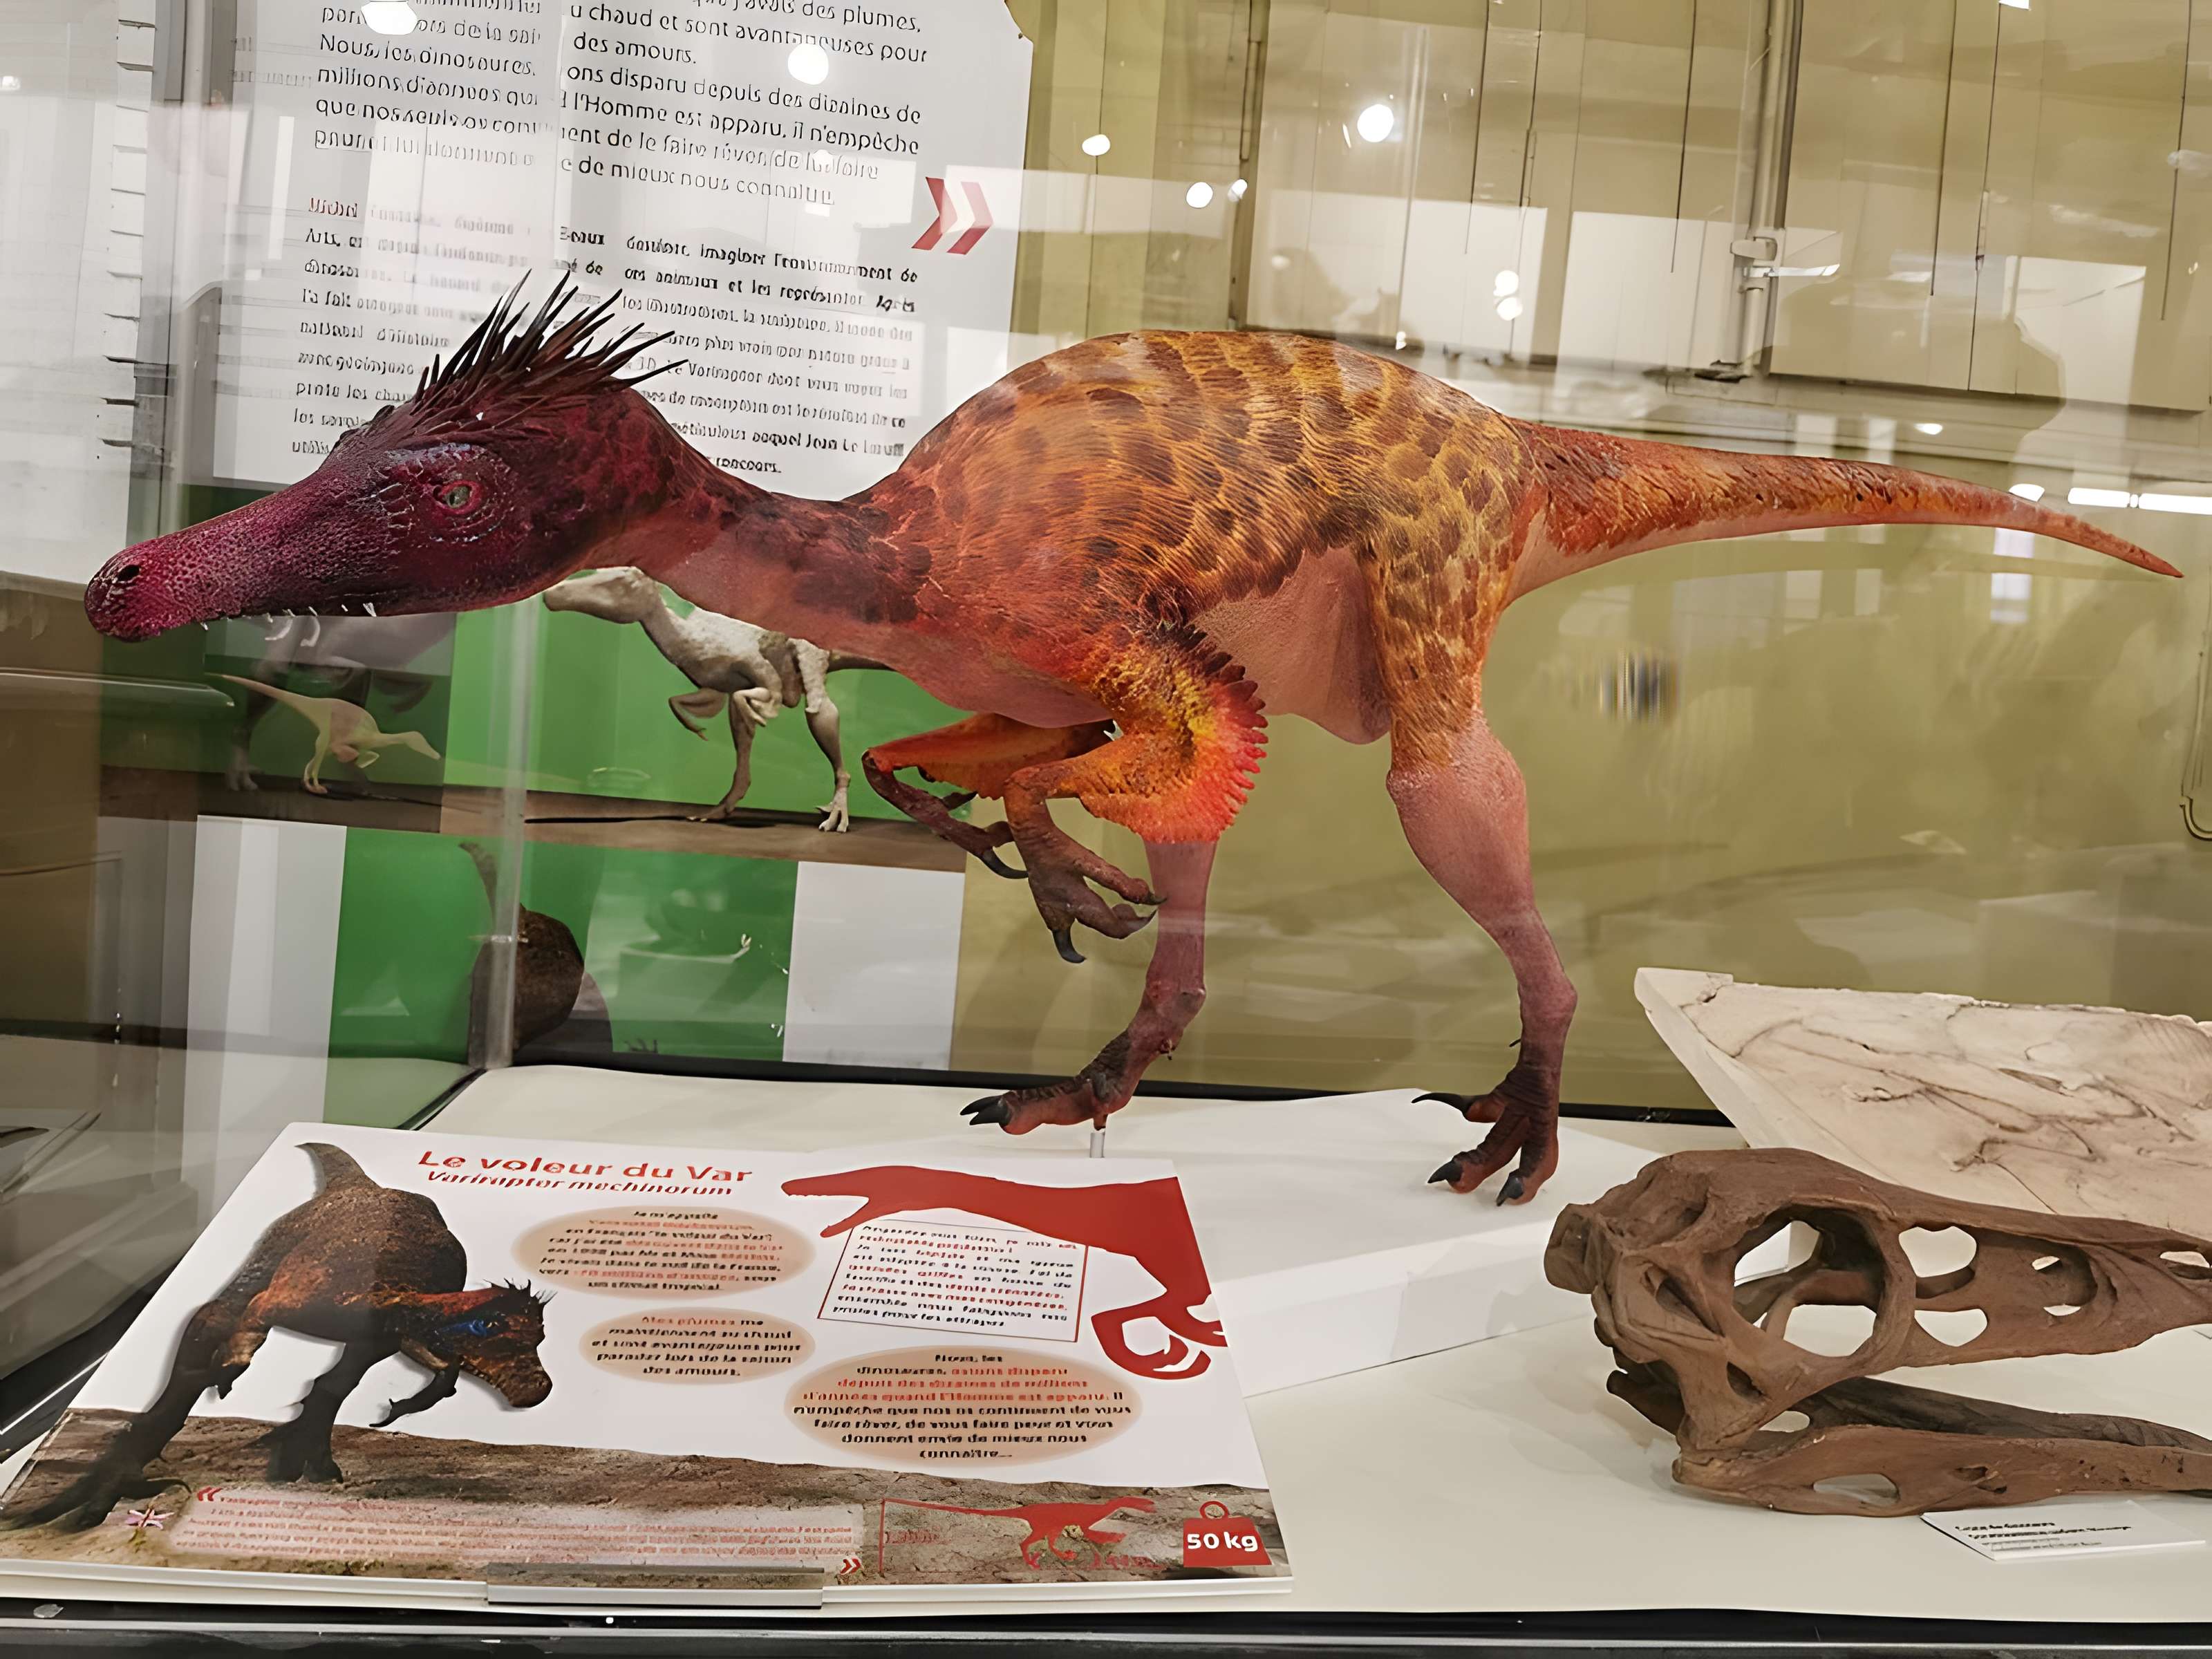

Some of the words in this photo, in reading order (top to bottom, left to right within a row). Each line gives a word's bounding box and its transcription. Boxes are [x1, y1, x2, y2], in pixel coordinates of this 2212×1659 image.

[574, 32, 608, 52] des
[590, 3, 652, 26] chaud
[685, 19, 729, 36] sont
[881, 45, 927, 62] pour
[418, 1151, 466, 1168] Le
[480, 1157, 613, 1175] voleur
[623, 1163, 674, 1179] du
[686, 1165, 753, 1181] Var
[1187, 1533, 1220, 1550] 50
[1223, 1531, 1259, 1552] kg
